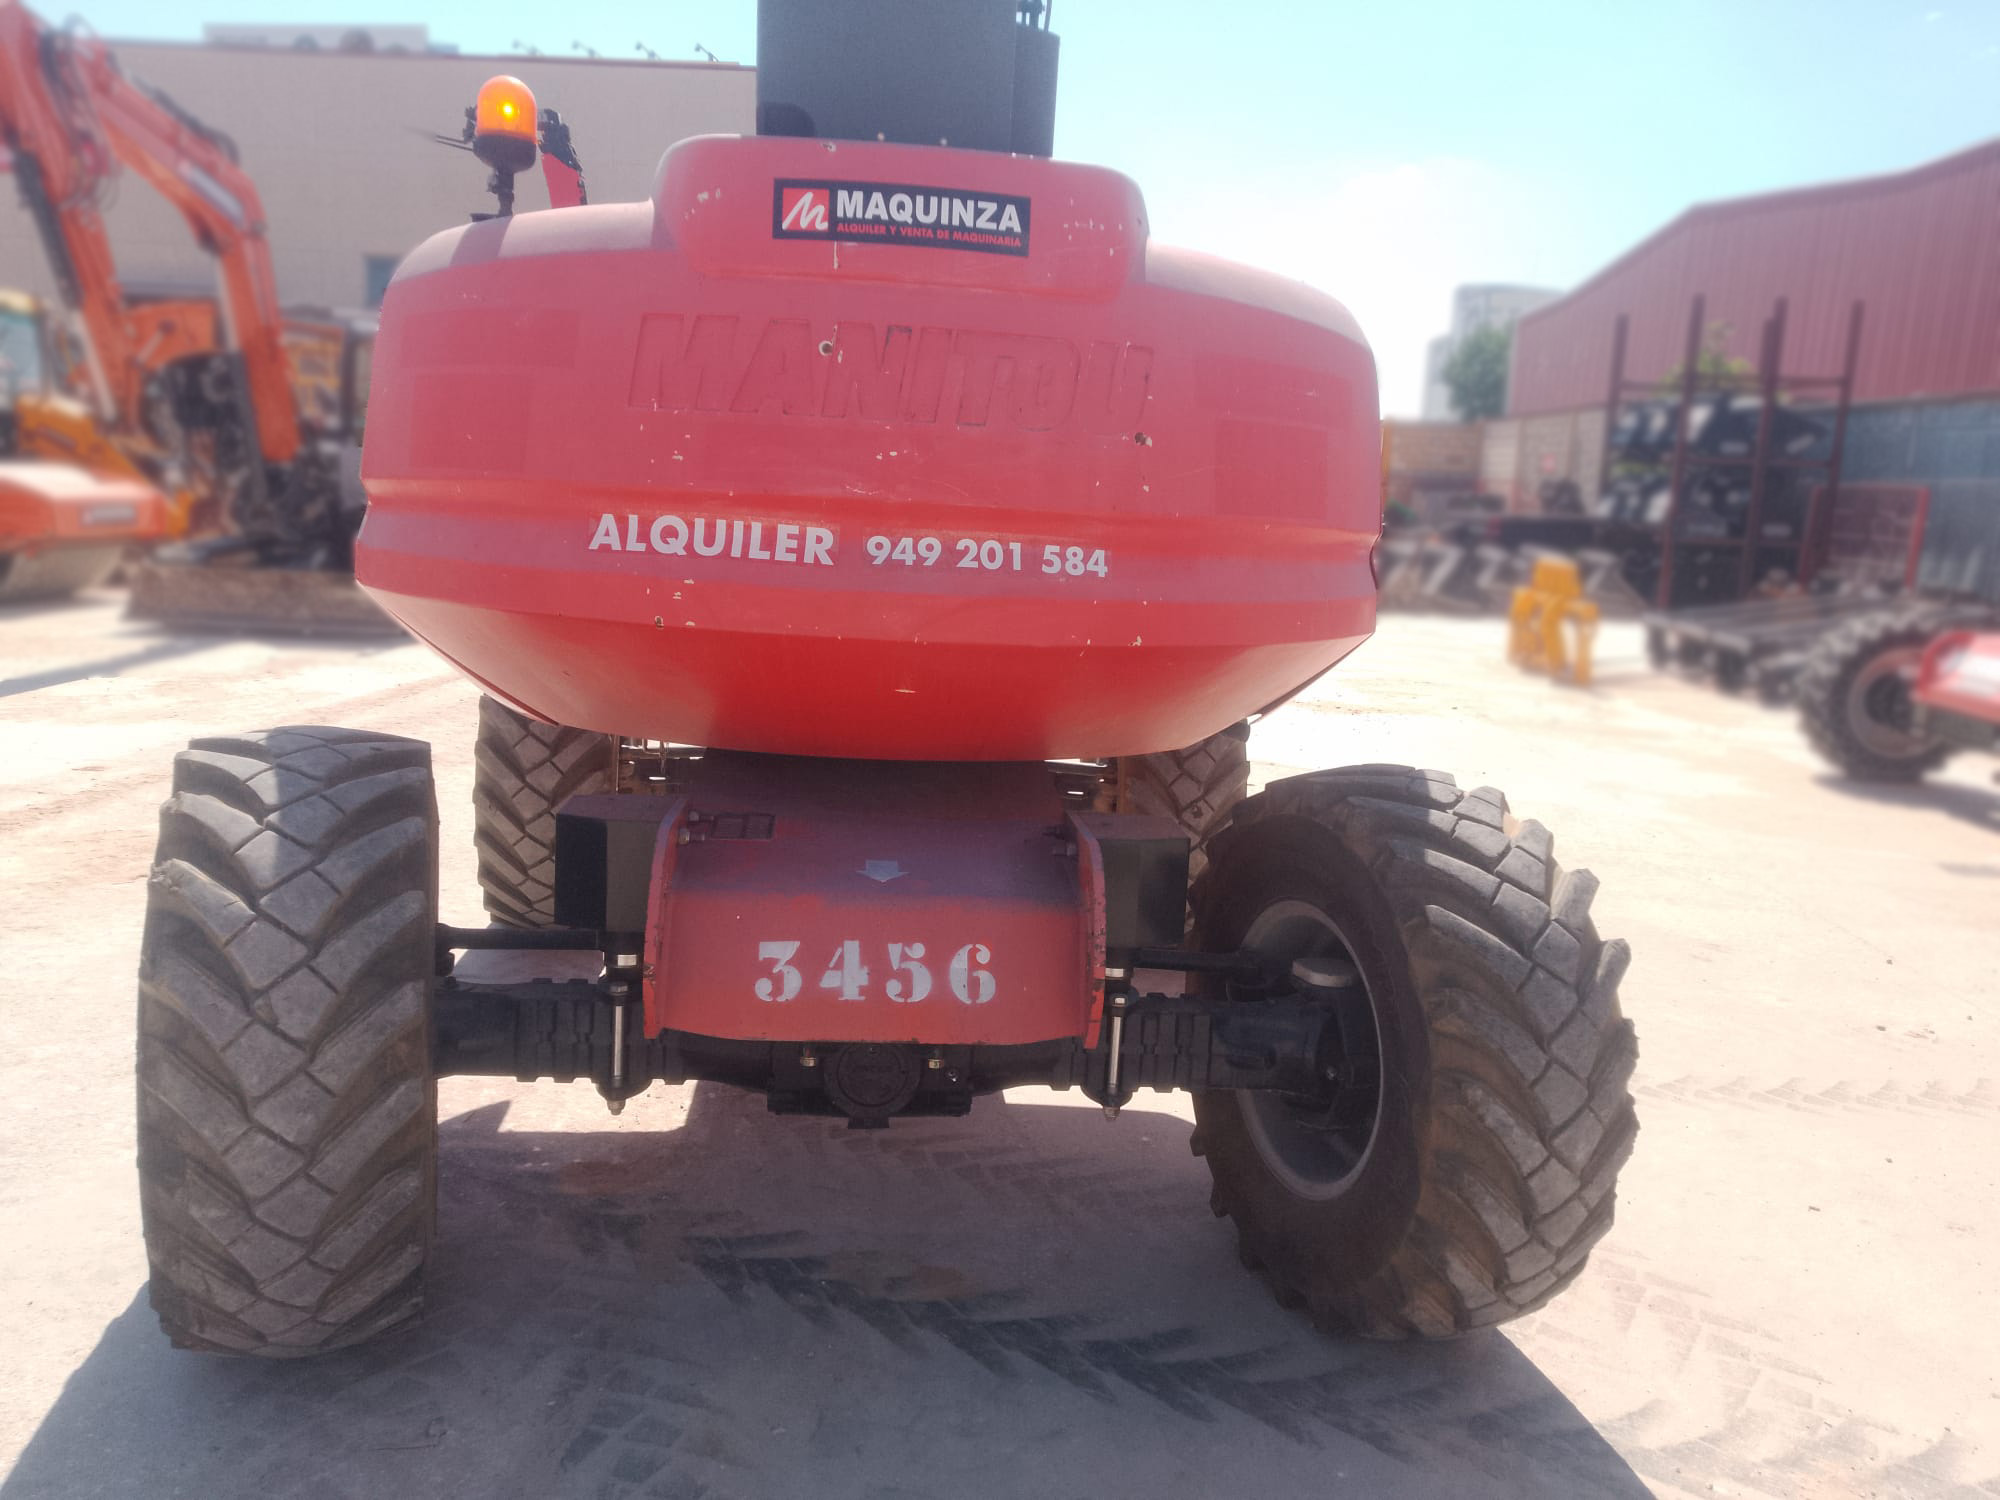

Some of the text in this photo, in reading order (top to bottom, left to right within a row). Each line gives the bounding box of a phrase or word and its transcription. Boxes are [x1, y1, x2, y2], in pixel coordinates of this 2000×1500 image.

[836, 189, 1022, 233] MAQUINZA
[837, 223, 1022, 247] ALQUILER Y VENTA DE MAQUINARIA
[627, 312, 1155, 436] MANITOU
[588, 513, 1109, 578] ALQUILER 949 201 584
[754, 939, 997, 1005] 3456
